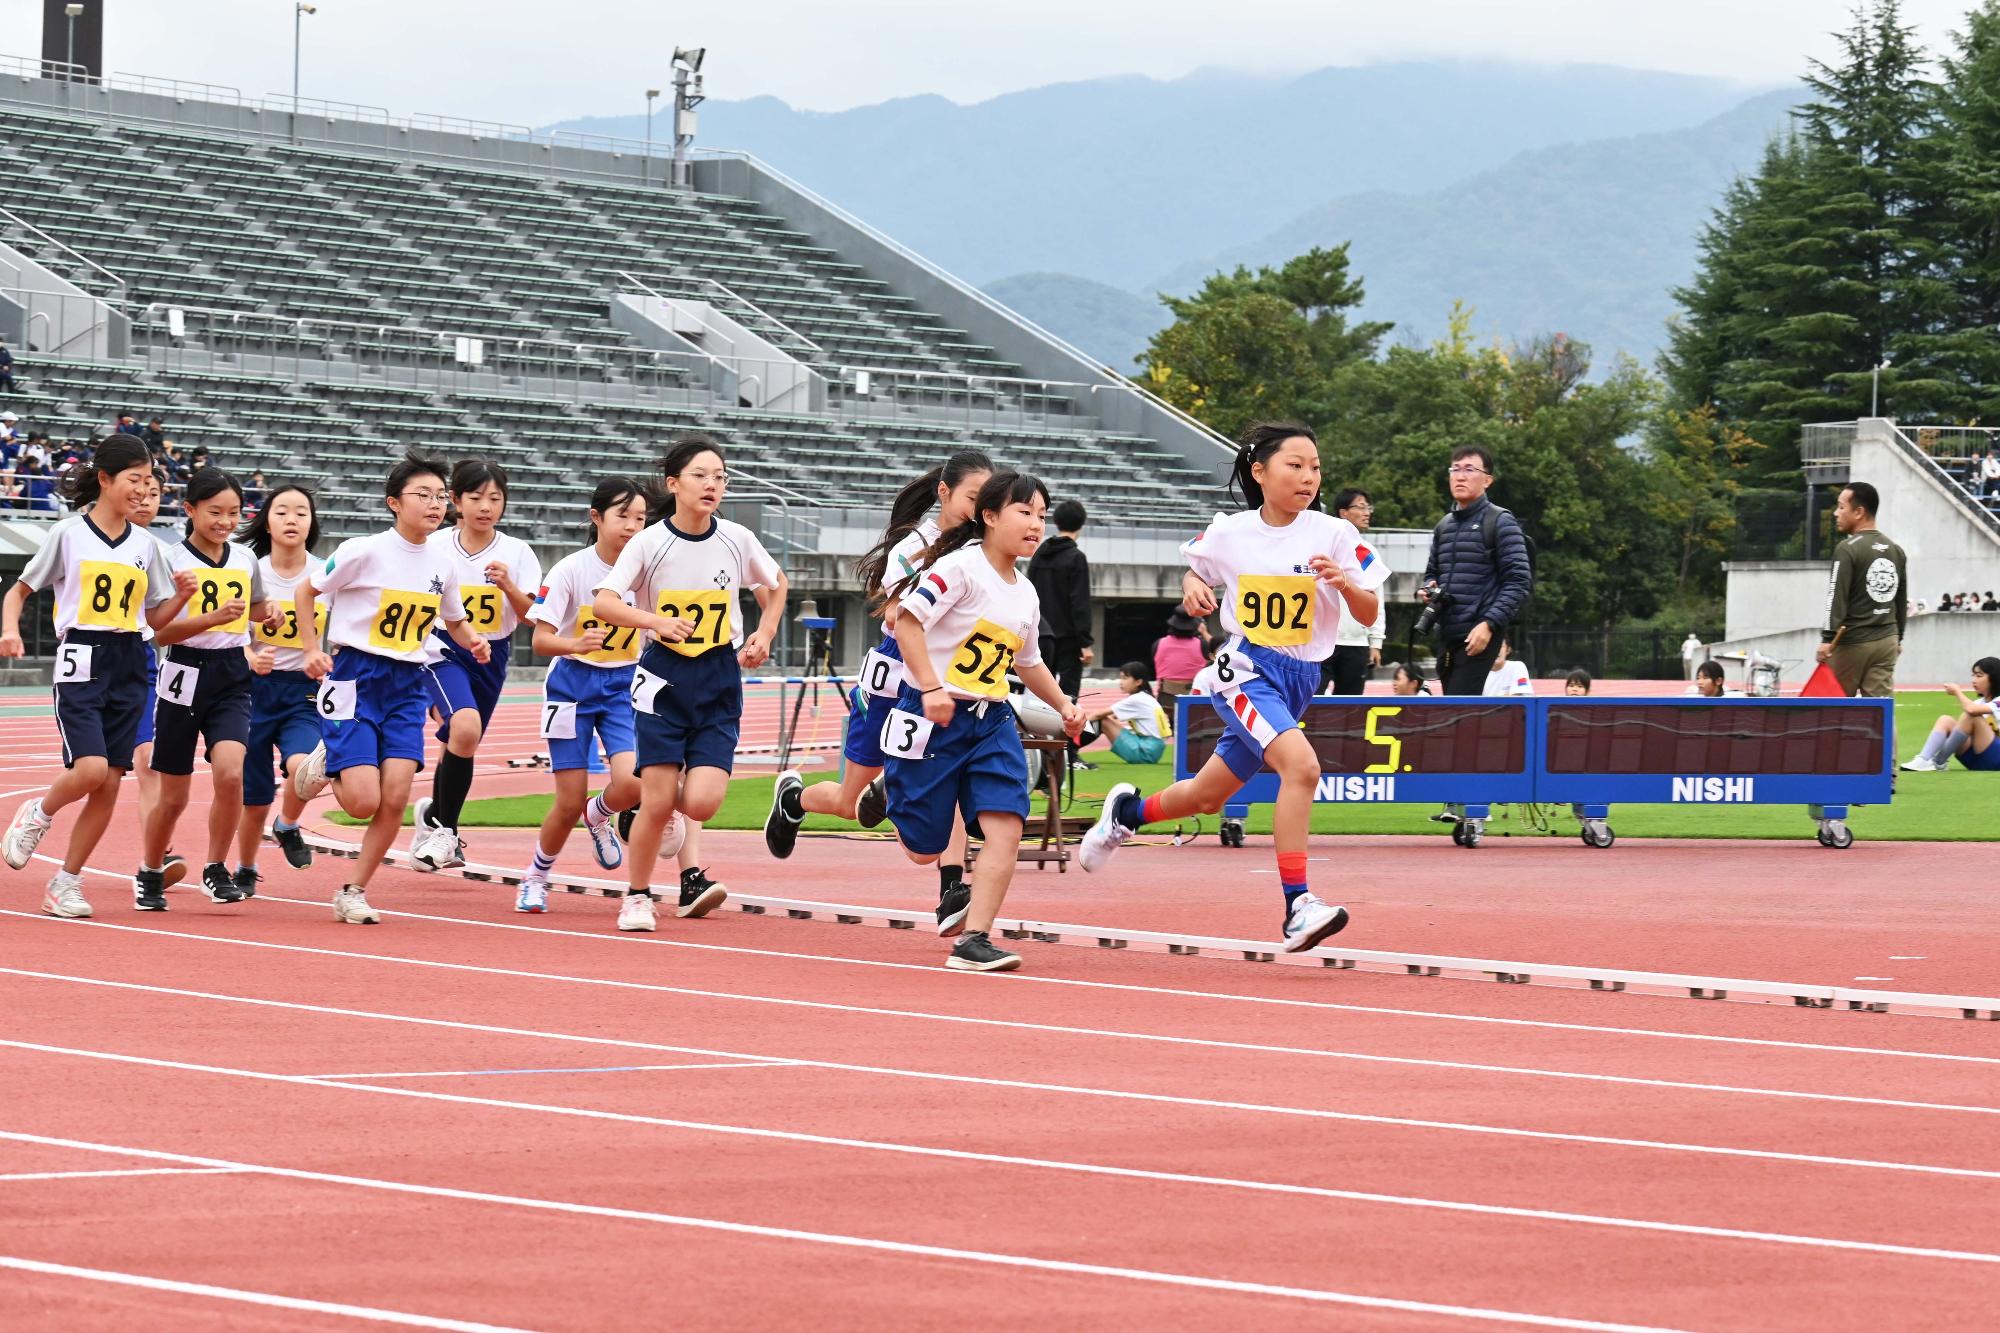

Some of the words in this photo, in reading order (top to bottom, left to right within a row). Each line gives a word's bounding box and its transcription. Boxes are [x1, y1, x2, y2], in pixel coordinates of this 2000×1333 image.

[379, 602, 437, 642] 817
[1242, 591, 1309, 630] 902
[62, 648, 78, 677] 5
[860, 652, 890, 692] 10
[1217, 652, 1235, 683] 8
[322, 685, 336, 715] 6
[545, 705, 560, 733] 7
[884, 713, 919, 753] 13
[1313, 776, 1395, 801] NISHI
[1671, 776, 1754, 801] NISHI
